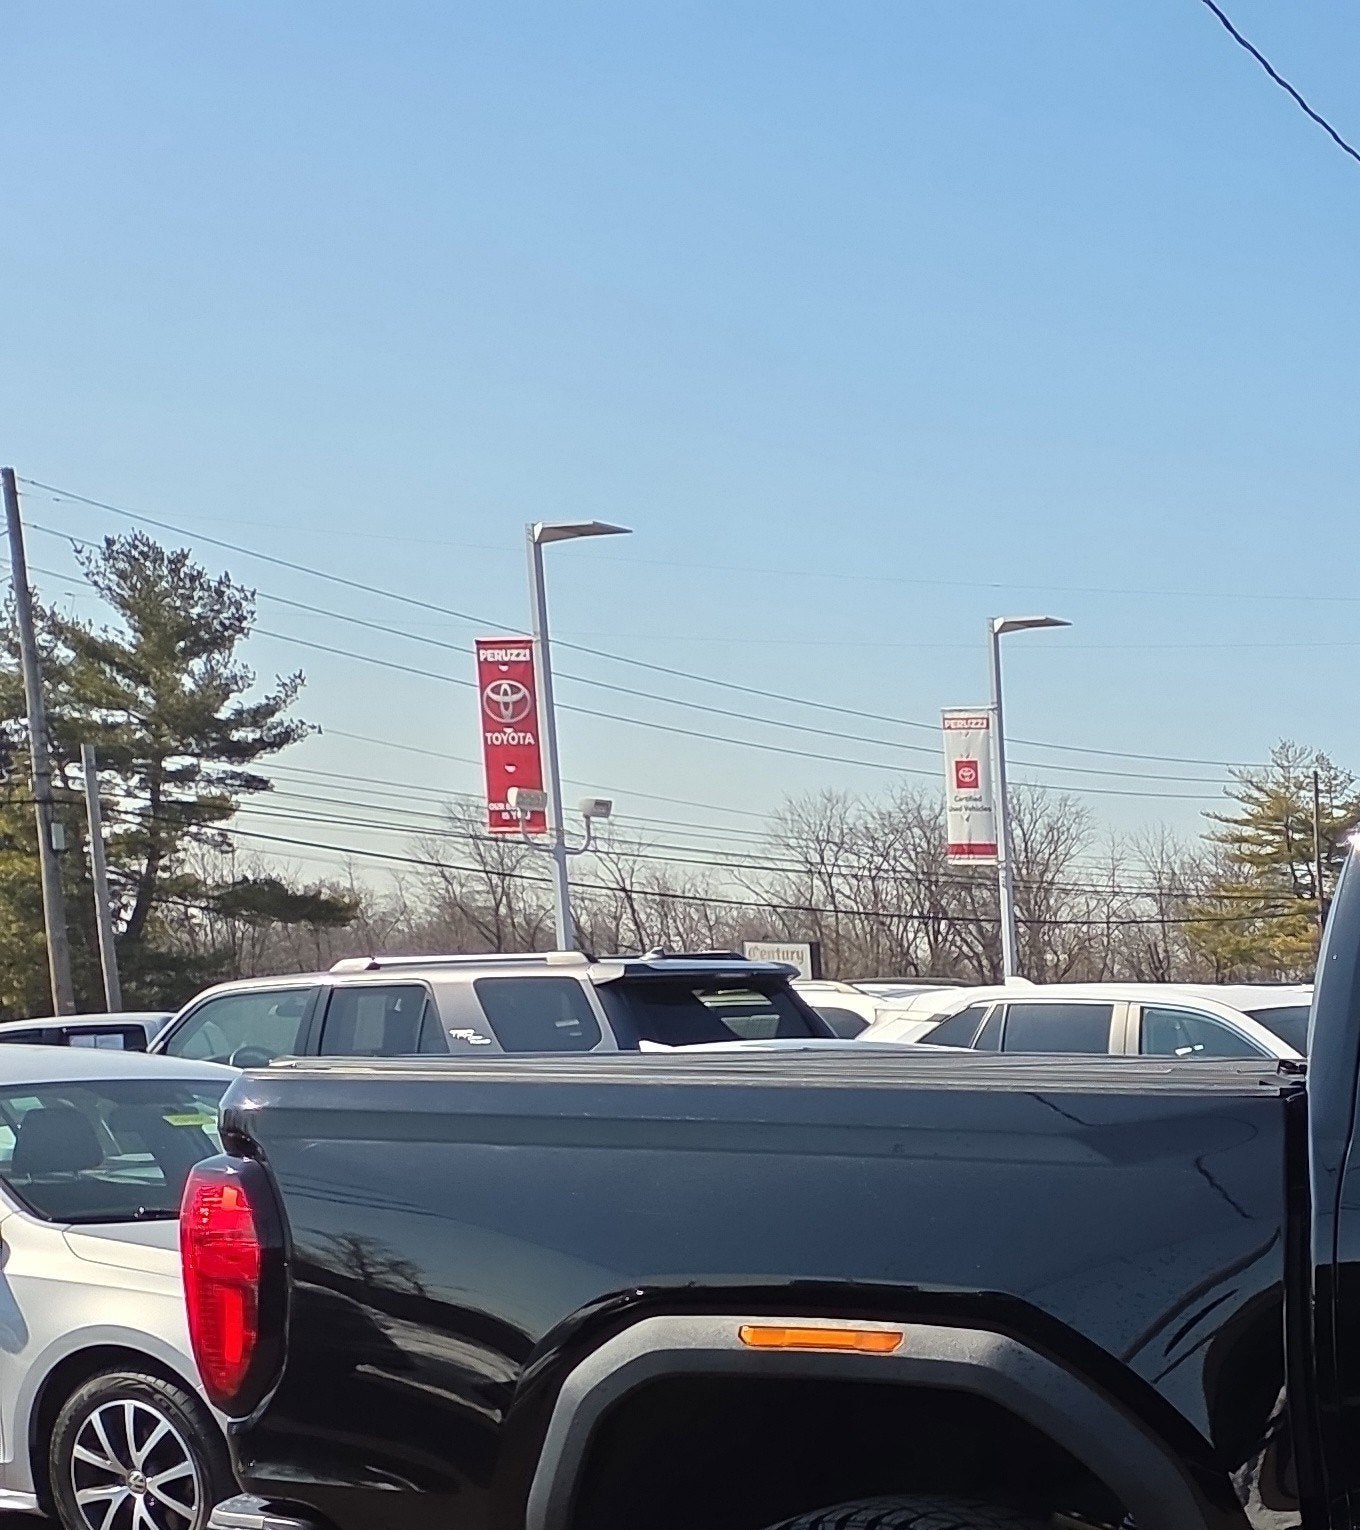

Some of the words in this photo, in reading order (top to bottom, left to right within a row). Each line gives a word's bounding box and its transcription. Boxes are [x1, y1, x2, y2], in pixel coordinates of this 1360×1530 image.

[480, 649, 530, 662] PERUZZI
[485, 732, 535, 746] TOYOTA
[748, 946, 805, 965] Century
